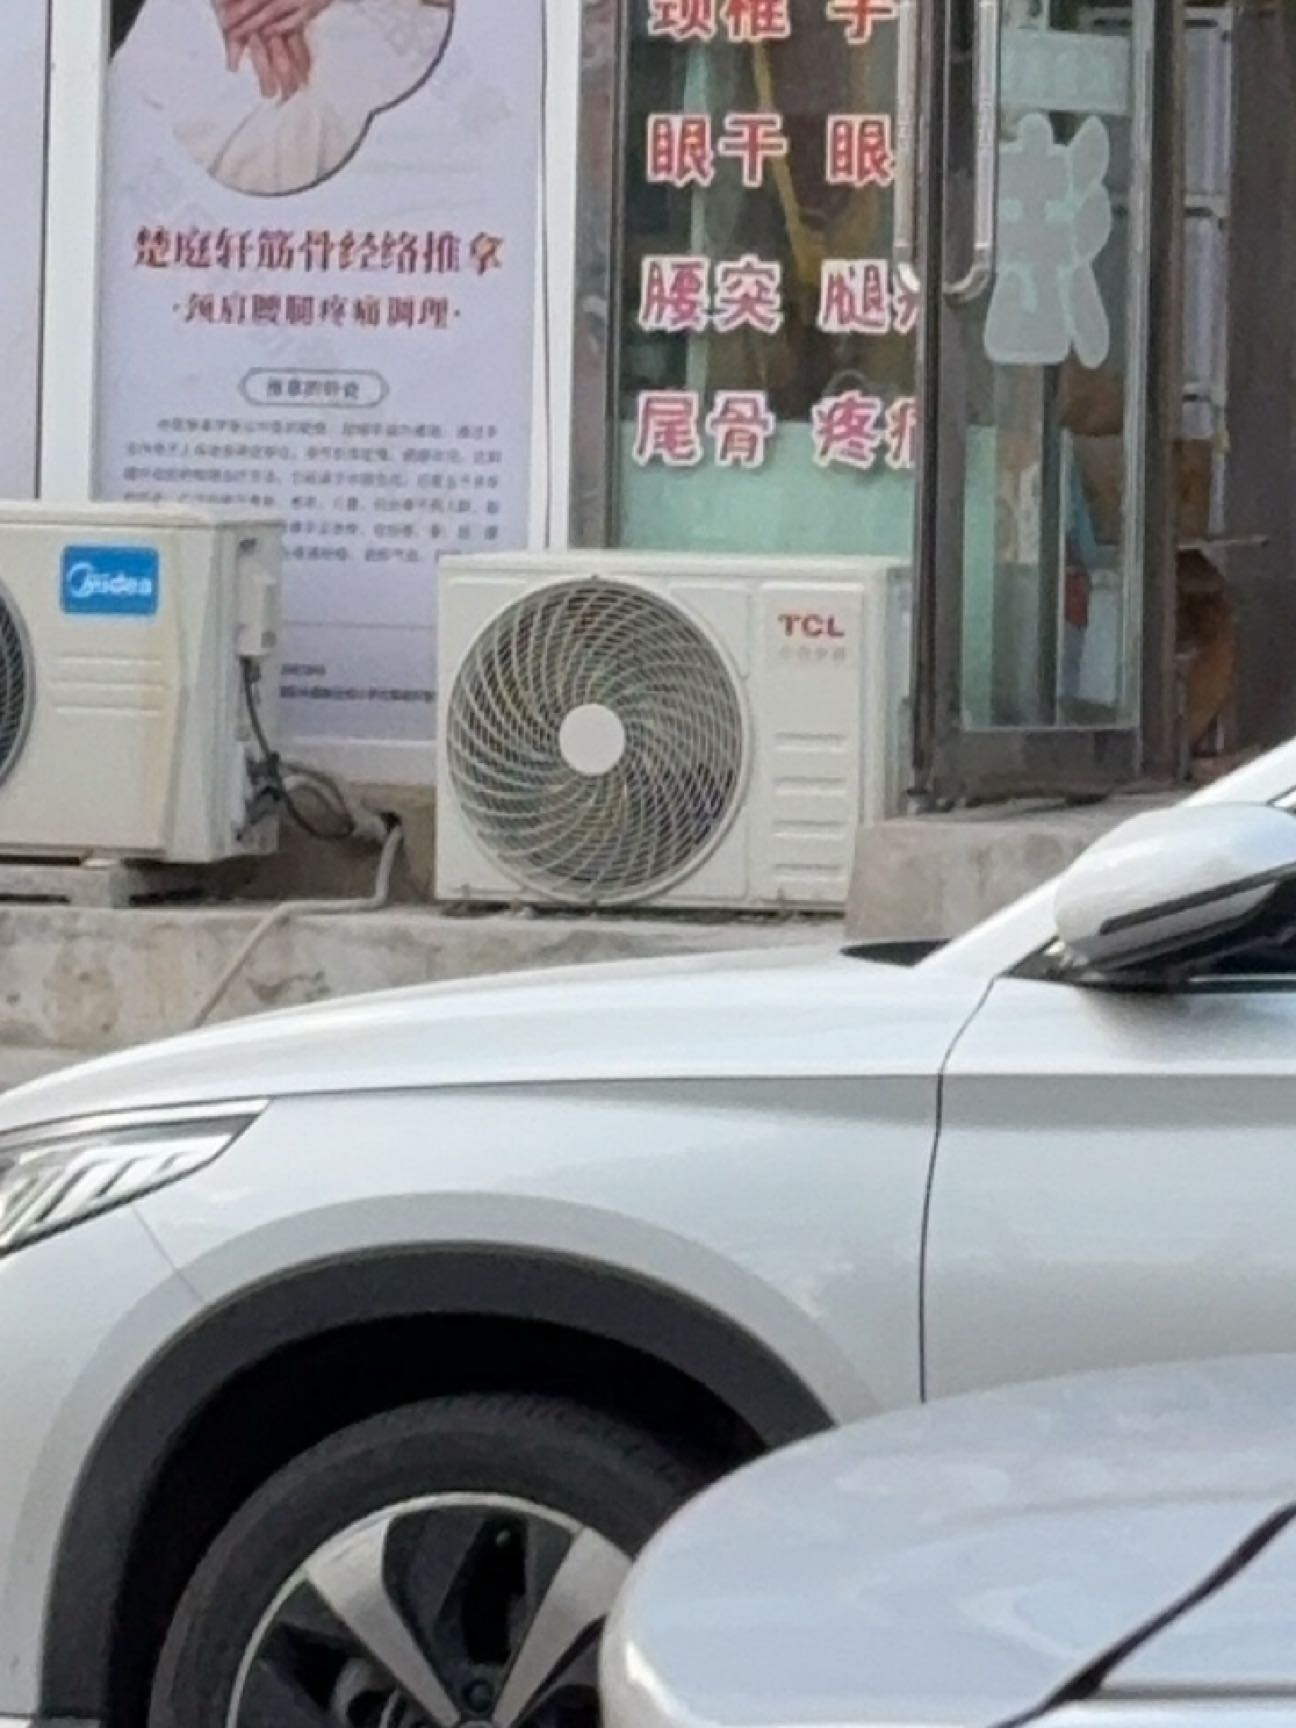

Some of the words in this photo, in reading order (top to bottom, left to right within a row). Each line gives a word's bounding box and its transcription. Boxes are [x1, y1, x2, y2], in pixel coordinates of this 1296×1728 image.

[647, 112, 789, 186] 眼干
[639, 254, 785, 334] 腰突
[633, 388, 775, 467] 尾骨
[67, 562, 153, 598] Midea
[777, 613, 845, 638] TCL
